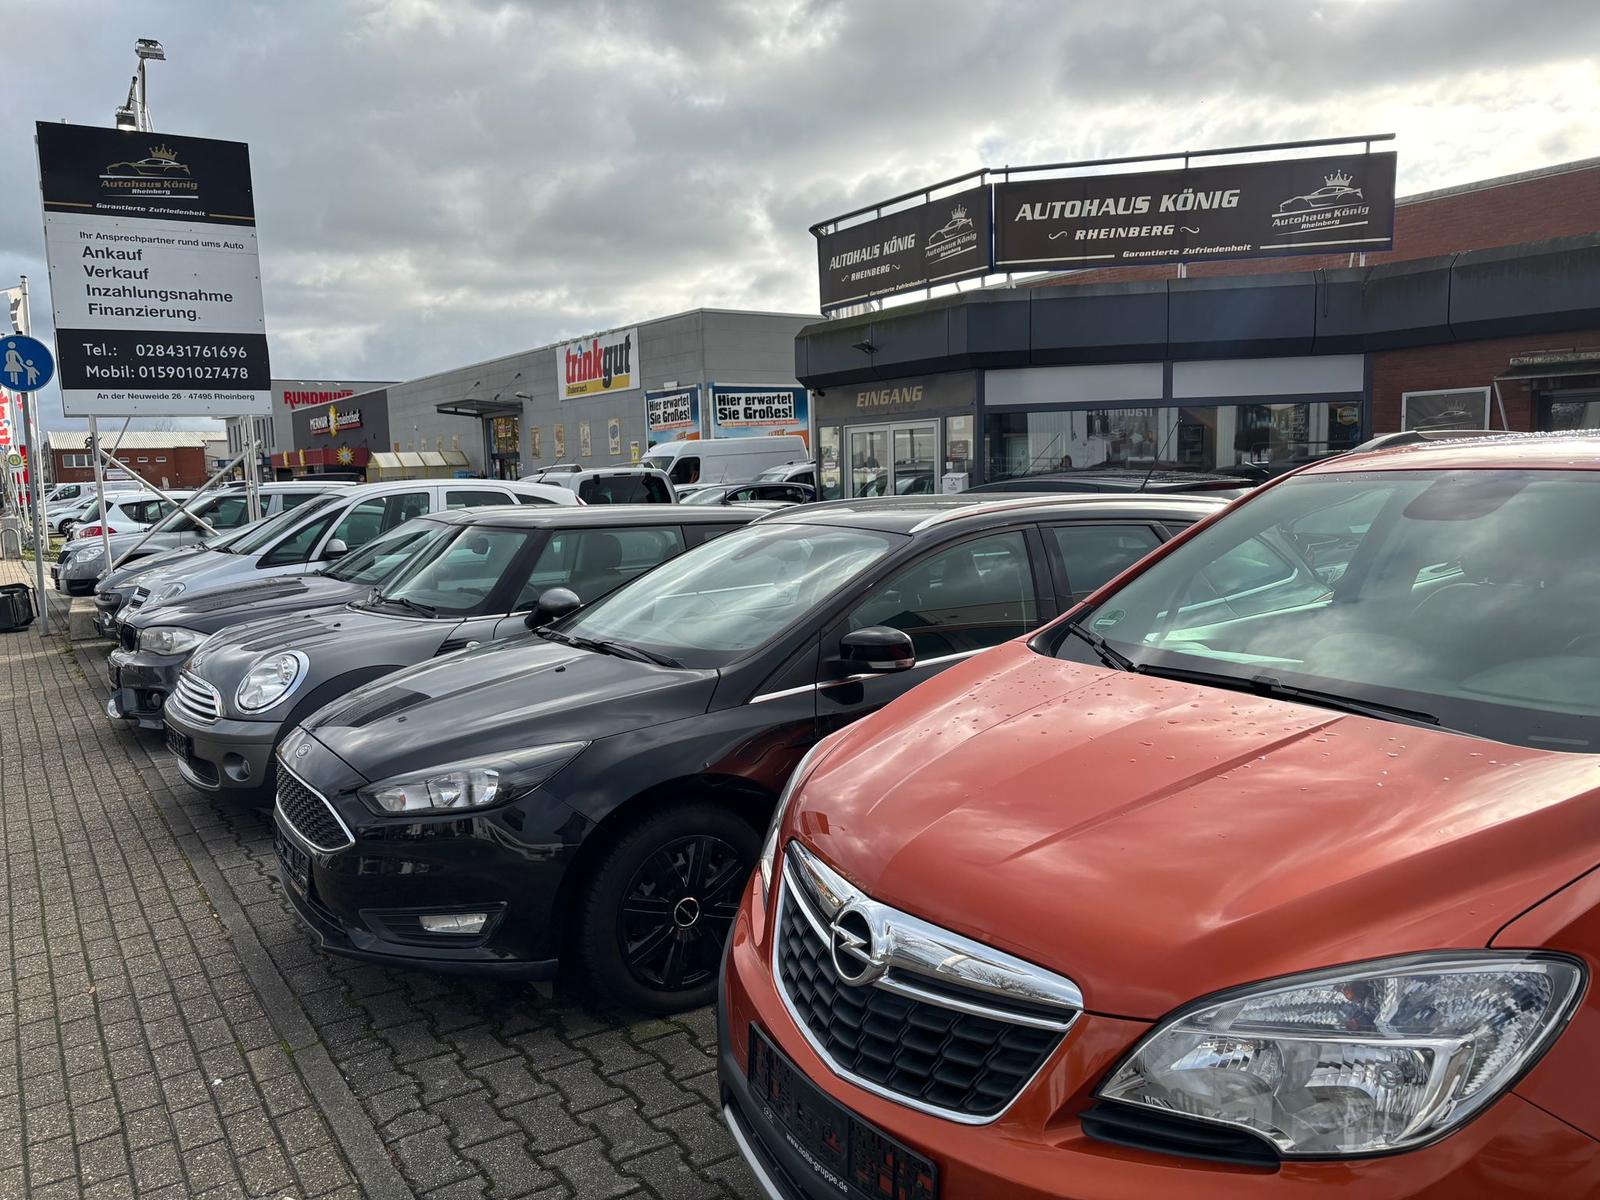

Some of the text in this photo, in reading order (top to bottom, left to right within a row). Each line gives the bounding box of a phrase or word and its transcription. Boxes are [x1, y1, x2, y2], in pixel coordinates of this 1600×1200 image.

[101, 180, 198, 190] Autohaus König
[96, 203, 206, 217] Garantierte Zufriedenheit
[1014, 188, 1241, 222] AUTOHAUS KÖNIG
[1272, 206, 1370, 227] Autohaus König
[1301, 219, 1340, 229] Rheinberg
[79, 231, 244, 250] Ihr Ansprechpartner rund ums Auto
[1074, 224, 1175, 241] RHEINBERG
[829, 233, 916, 271] AUTOHAUS KÖNIG
[925, 232, 977, 258] Autohaus König
[1122, 244, 1252, 258] Garantierte Zufriedenheit
[82, 246, 143, 261] Ankauf
[83, 265, 149, 280] Verkauf
[851, 264, 890, 281] RHEINBERG
[86, 284, 233, 302] Inzahlungsnahme
[83, 343, 247, 359] Tel.: 028431761696
[566, 333, 632, 388] trinkgut
[138, 366, 249, 379] 015901027478
[97, 392, 109, 400] An
[111, 392, 125, 400] der
[127, 392, 170, 400] Neuweide
[188, 392, 213, 400] 47495
[214, 393, 255, 401] Rheinberg
[649, 395, 690, 412] Hier erwartet
[718, 394, 792, 406] Hier erwartet
[856, 385, 924, 408] EINGANG
[650, 412, 662, 425] Sie
[718, 406, 793, 421] Sie Großes!
